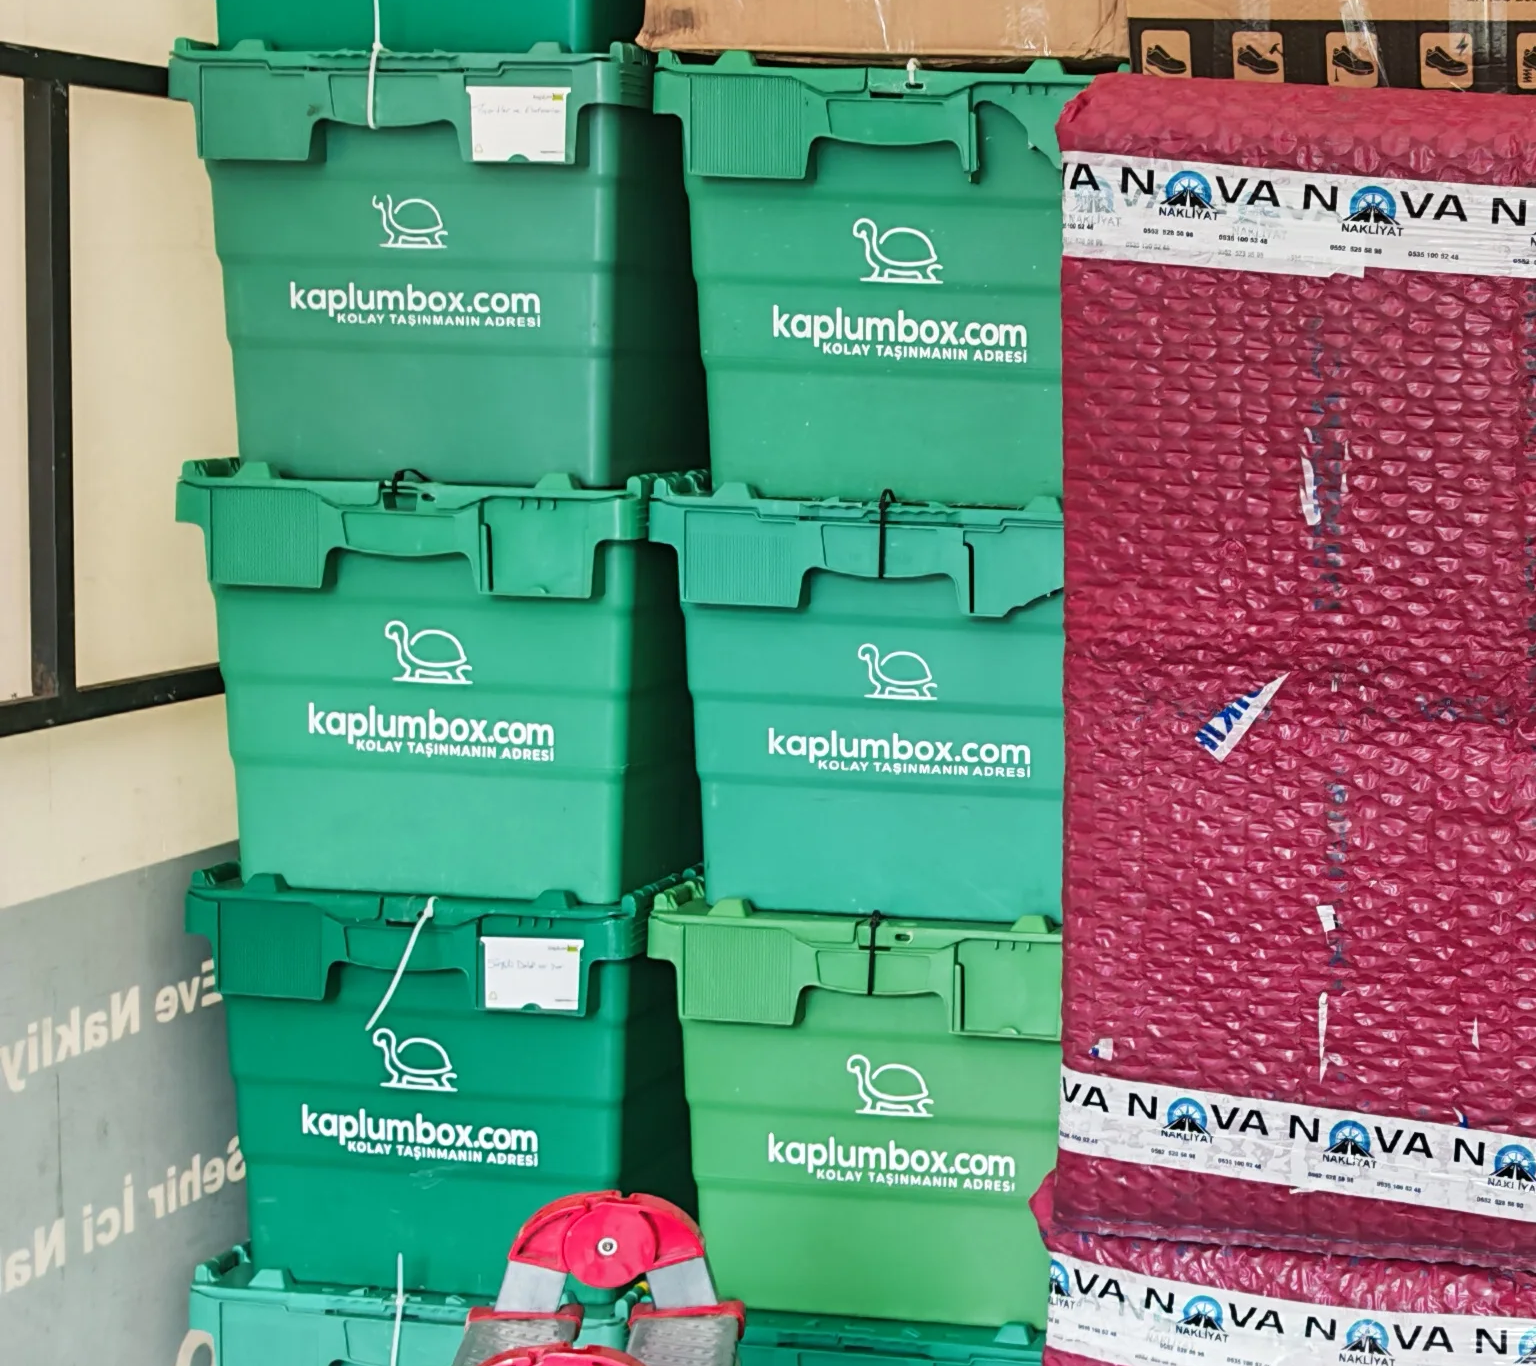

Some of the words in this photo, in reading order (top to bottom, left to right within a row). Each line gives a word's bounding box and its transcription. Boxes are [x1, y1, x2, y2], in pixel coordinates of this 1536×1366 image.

[1341, 222, 1404, 237] NAKLİYAT
[290, 281, 541, 317] kaplumbox.com
[338, 313, 384, 324] KOLAY
[389, 313, 480, 327] TAŞINMANIN
[485, 315, 541, 328] ADRESİ
[773, 305, 1027, 348] kaplumbox.com
[823, 342, 870, 356] KOLAY
[877, 345, 968, 360] TAŞINMANIN
[973, 349, 1027, 363] ADRESİ
[308, 702, 554, 746] kaplumbox.com
[356, 740, 401, 753] KOLAY
[408, 742, 496, 758] TAŞINMANIN
[501, 747, 554, 762] ADRESİ
[768, 727, 1031, 764] kaplumbox.com
[818, 759, 869, 773] KOLAY
[873, 762, 968, 776] TAŞINMANIN
[973, 765, 1031, 778] ADRESİ
[302, 1104, 539, 1153] kaplumbox.com
[348, 1141, 392, 1156] KOLAY
[396, 1144, 482, 1164] TAŞINMANIN
[487, 1152, 539, 1167] ADRESİ
[768, 1132, 1015, 1177] kaplumbox.com
[817, 1169, 863, 1183] KOLAY
[868, 1171, 958, 1189] TAŞINMANIN
[963, 1178, 1015, 1192] ADRESİ
[1175, 1325, 1230, 1344] NAKLİYAT
